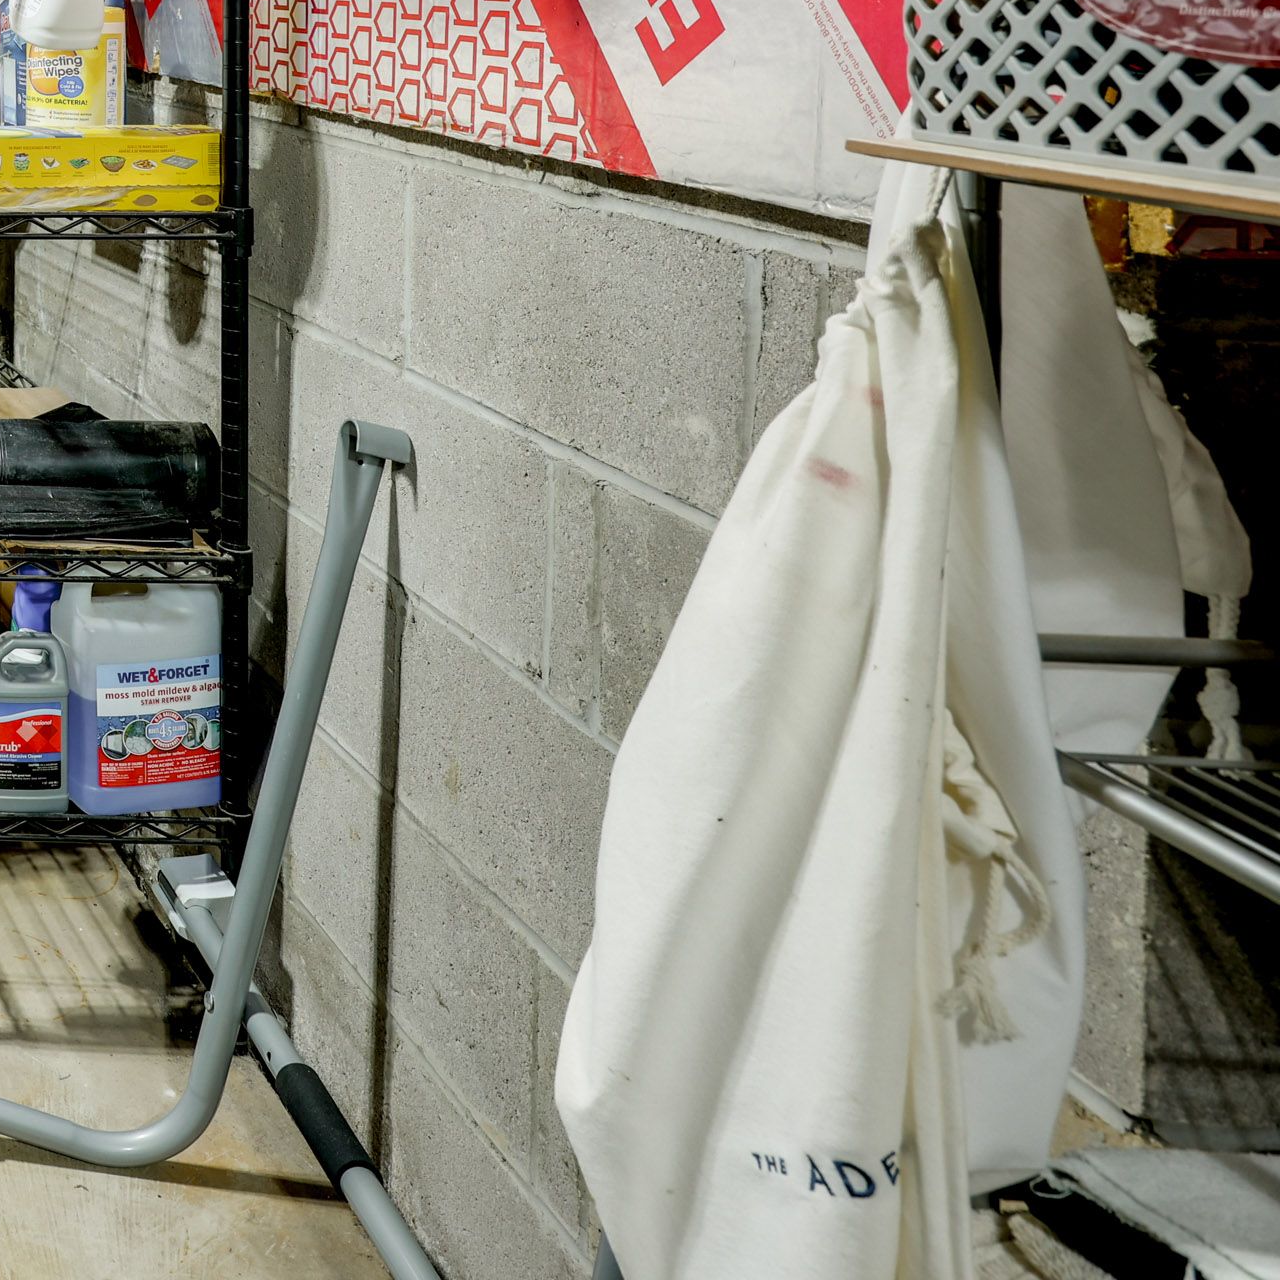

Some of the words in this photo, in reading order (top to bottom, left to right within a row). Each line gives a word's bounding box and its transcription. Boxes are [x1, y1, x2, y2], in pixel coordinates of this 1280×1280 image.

[1178, 3, 1259, 19] Distinctively
[808, 8, 831, 38] BURN.
[822, 34, 843, 60] WILL
[838, 39, 862, 71] quality
[27, 54, 83, 69] Disinfecting
[43, 65, 81, 79] Wipes
[835, 57, 867, 105] PRODUCT
[854, 68, 869, 86] the
[44, 97, 53, 105] OF
[53, 97, 89, 106] BACTERIA!
[863, 83, 885, 114] meets
[860, 101, 879, 126] THIS
[105, 691, 129, 700] moss
[132, 689, 156, 698] mold
[157, 685, 190, 696] mildew
[191, 685, 198, 693] &
[140, 698, 160, 706] STAIN
[161, 695, 192, 704] REMOVER
[22, 719, 53, 727] Professional
[750, 1151, 789, 1177] THE
